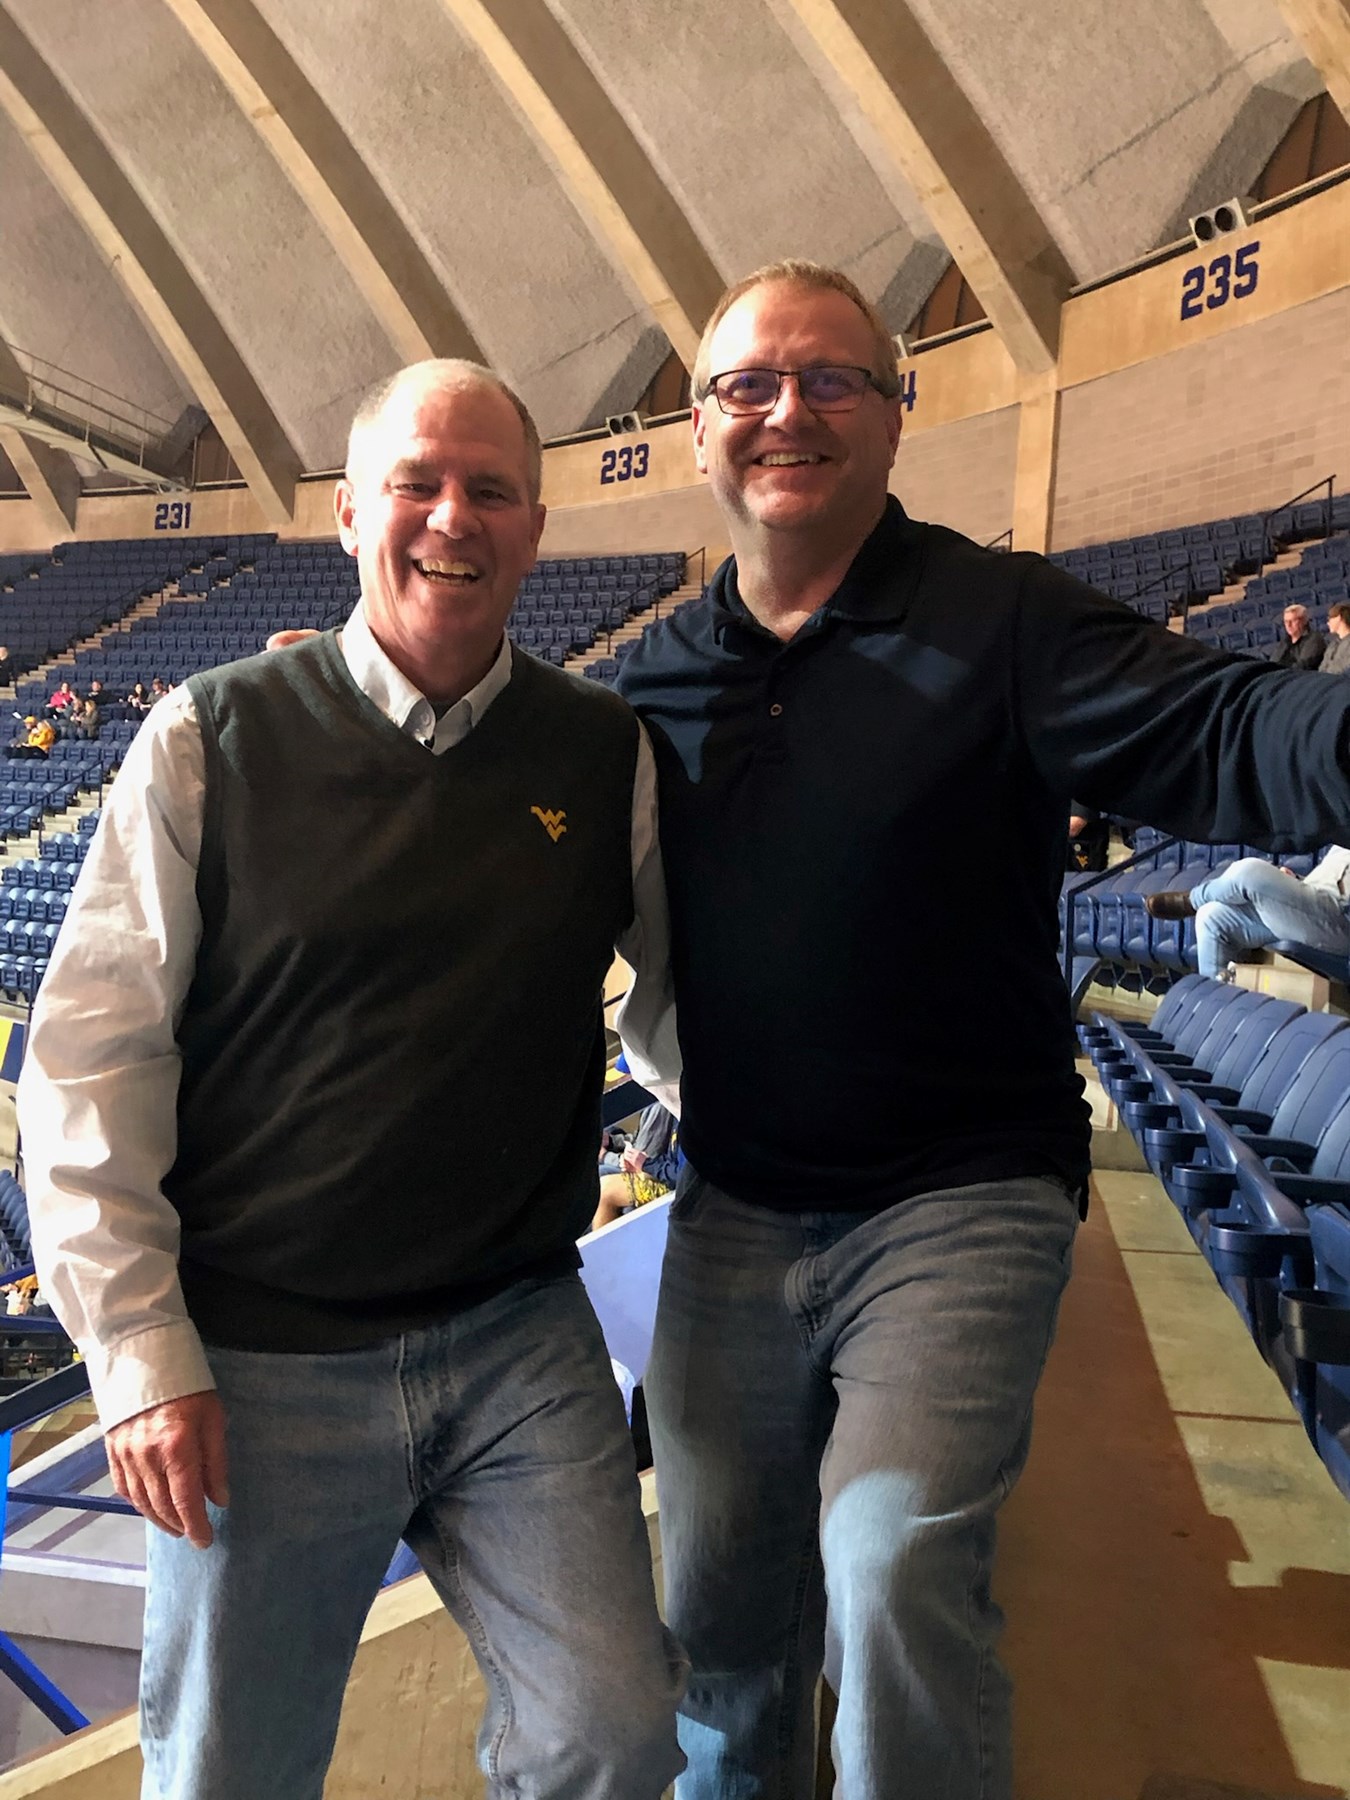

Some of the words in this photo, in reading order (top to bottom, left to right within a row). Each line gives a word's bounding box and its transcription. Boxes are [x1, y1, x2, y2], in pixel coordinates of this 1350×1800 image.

[1181, 241, 1260, 321] 235
[600, 443, 649, 485] 233
[154, 502, 191, 530] 231
